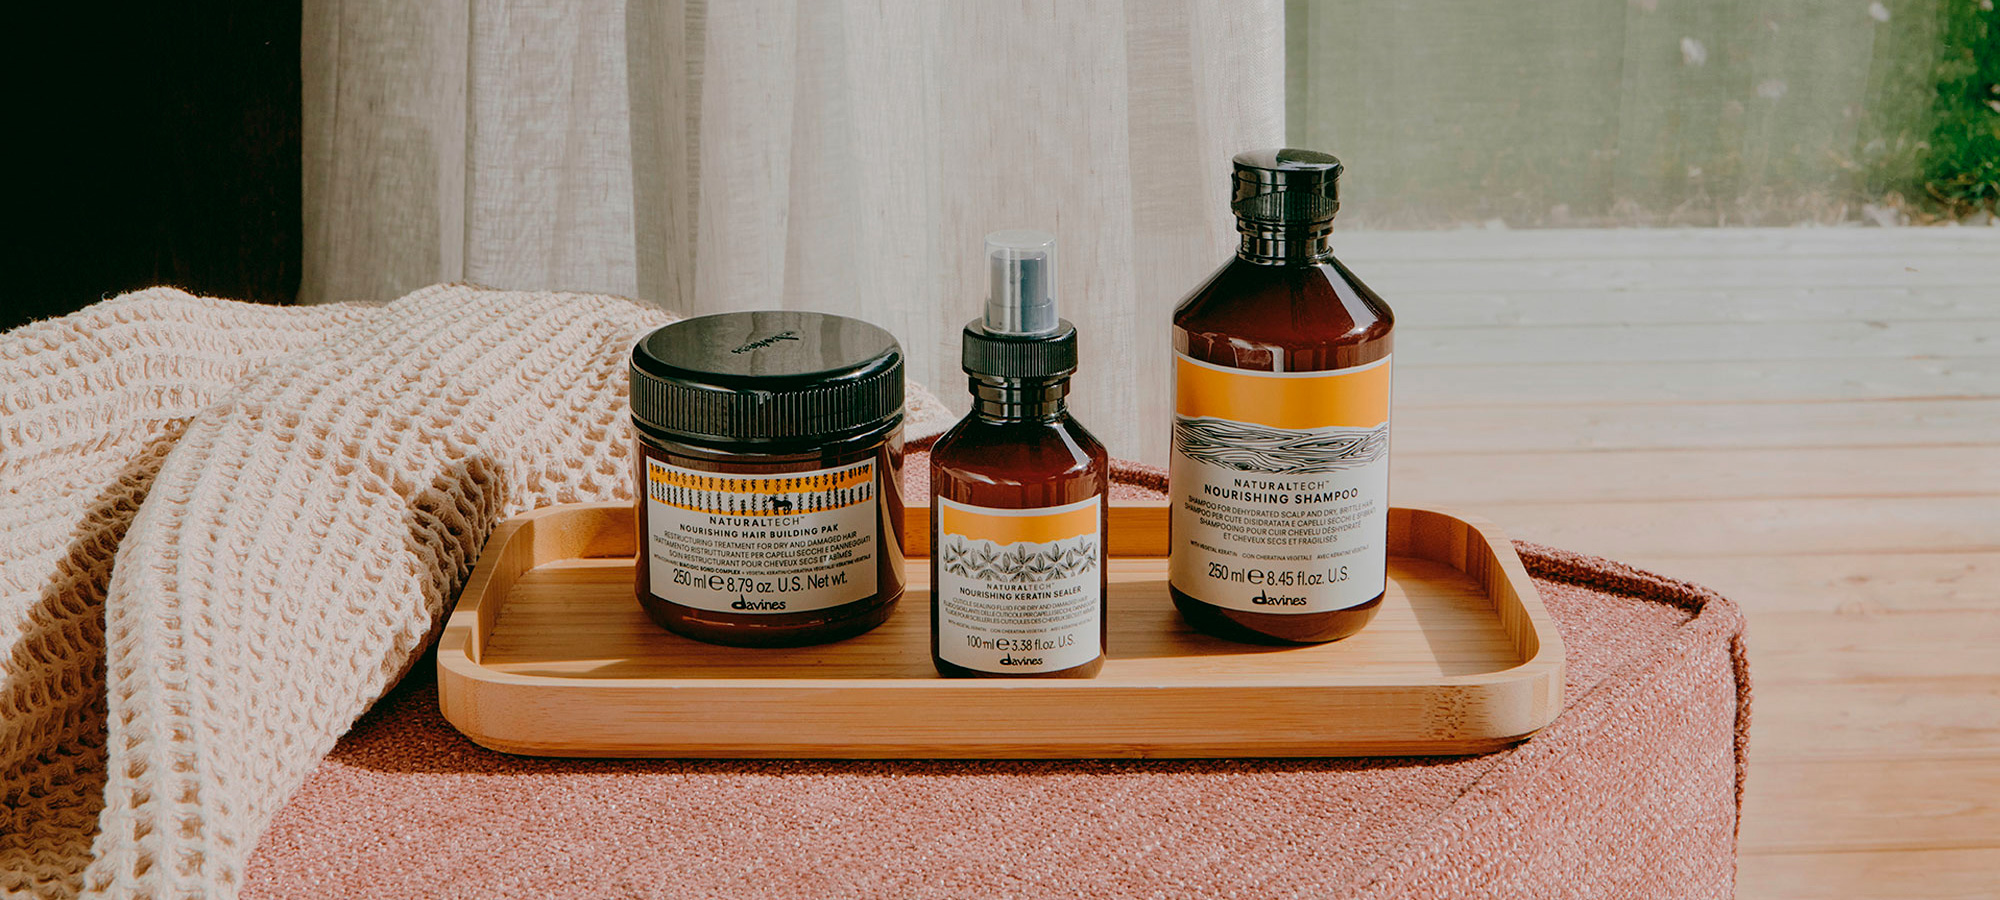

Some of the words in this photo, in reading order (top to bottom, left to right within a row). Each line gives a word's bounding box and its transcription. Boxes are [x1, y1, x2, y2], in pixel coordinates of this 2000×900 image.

[1204, 484, 1289, 504] NOURISHING
[1294, 487, 1358, 504] SHAMPOO
[1184, 502, 1211, 518] SHAMPOO
[1211, 511, 1223, 520] PER
[1224, 514, 1242, 524] CUTE
[1243, 517, 1290, 527] DISIDRATATA
[1297, 519, 1326, 527] CAPELLI
[1327, 515, 1351, 525] SECCHI
[1188, 495, 1217, 510] SHAMPOO
[1217, 504, 1231, 513] FOR
[1232, 507, 1280, 518] DEHYDRATED
[1281, 510, 1305, 518] SCALP
[1306, 509, 1322, 517] AND
[680, 523, 738, 538] NOURISHING
[742, 531, 766, 539] HAIR
[770, 527, 818, 539] BUILDING
[821, 523, 839, 534] PAK
[1200, 516, 1245, 533] SHAMPOOING
[1246, 526, 1267, 535] POUR
[1268, 528, 1287, 536] CUIR
[1287, 528, 1321, 536] CHEVELU
[653, 534, 690, 552] TRATTAMENTO
[691, 546, 749, 558] RISTRUTTURANTE
[765, 551, 795, 559] CAPELLI
[796, 547, 824, 557] SECCHI
[664, 530, 713, 547] RESTRUCTURING
[714, 540, 755, 550] TREATMENT
[757, 542, 772, 550] FOR
[773, 542, 789, 550] DRY
[789, 540, 806, 549] AND
[807, 535, 842, 547] DAMAGED
[842, 530, 857, 540] HAIR
[1223, 532, 1231, 540] ET
[1232, 534, 1266, 544] CHEVEUX
[1266, 537, 1287, 545] SECS
[669, 549, 684, 559] SOIN
[684, 553, 740, 567] RESTRUCTURANT
[741, 560, 762, 568] POUR
[763, 559, 798, 568] CHEVEUX
[799, 557, 818, 566] SECS
[819, 555, 827, 563] ET
[673, 568, 691, 586] 250
[694, 574, 706, 589] ml
[727, 577, 753, 593] 8.79
[756, 582, 774, 593] oz.
[778, 576, 804, 592] U.S.
[808, 574, 829, 590] Net
[831, 570, 848, 586] wt.
[1208, 561, 1229, 580] 250
[1231, 568, 1245, 583] ml
[1266, 571, 1294, 586] 8.45
[1328, 565, 1350, 583] U.S.
[731, 593, 786, 610] davines
[960, 587, 1012, 600] NOURISHING
[1015, 592, 1052, 600] KERATIN
[1053, 585, 1081, 598] SEALER
[1252, 589, 1307, 606] davines
[967, 635, 982, 648] 100
[982, 638, 994, 650] ml
[1012, 639, 1033, 652] 3.38
[1058, 633, 1076, 648] U.S.
[1000, 653, 1043, 666] davines
